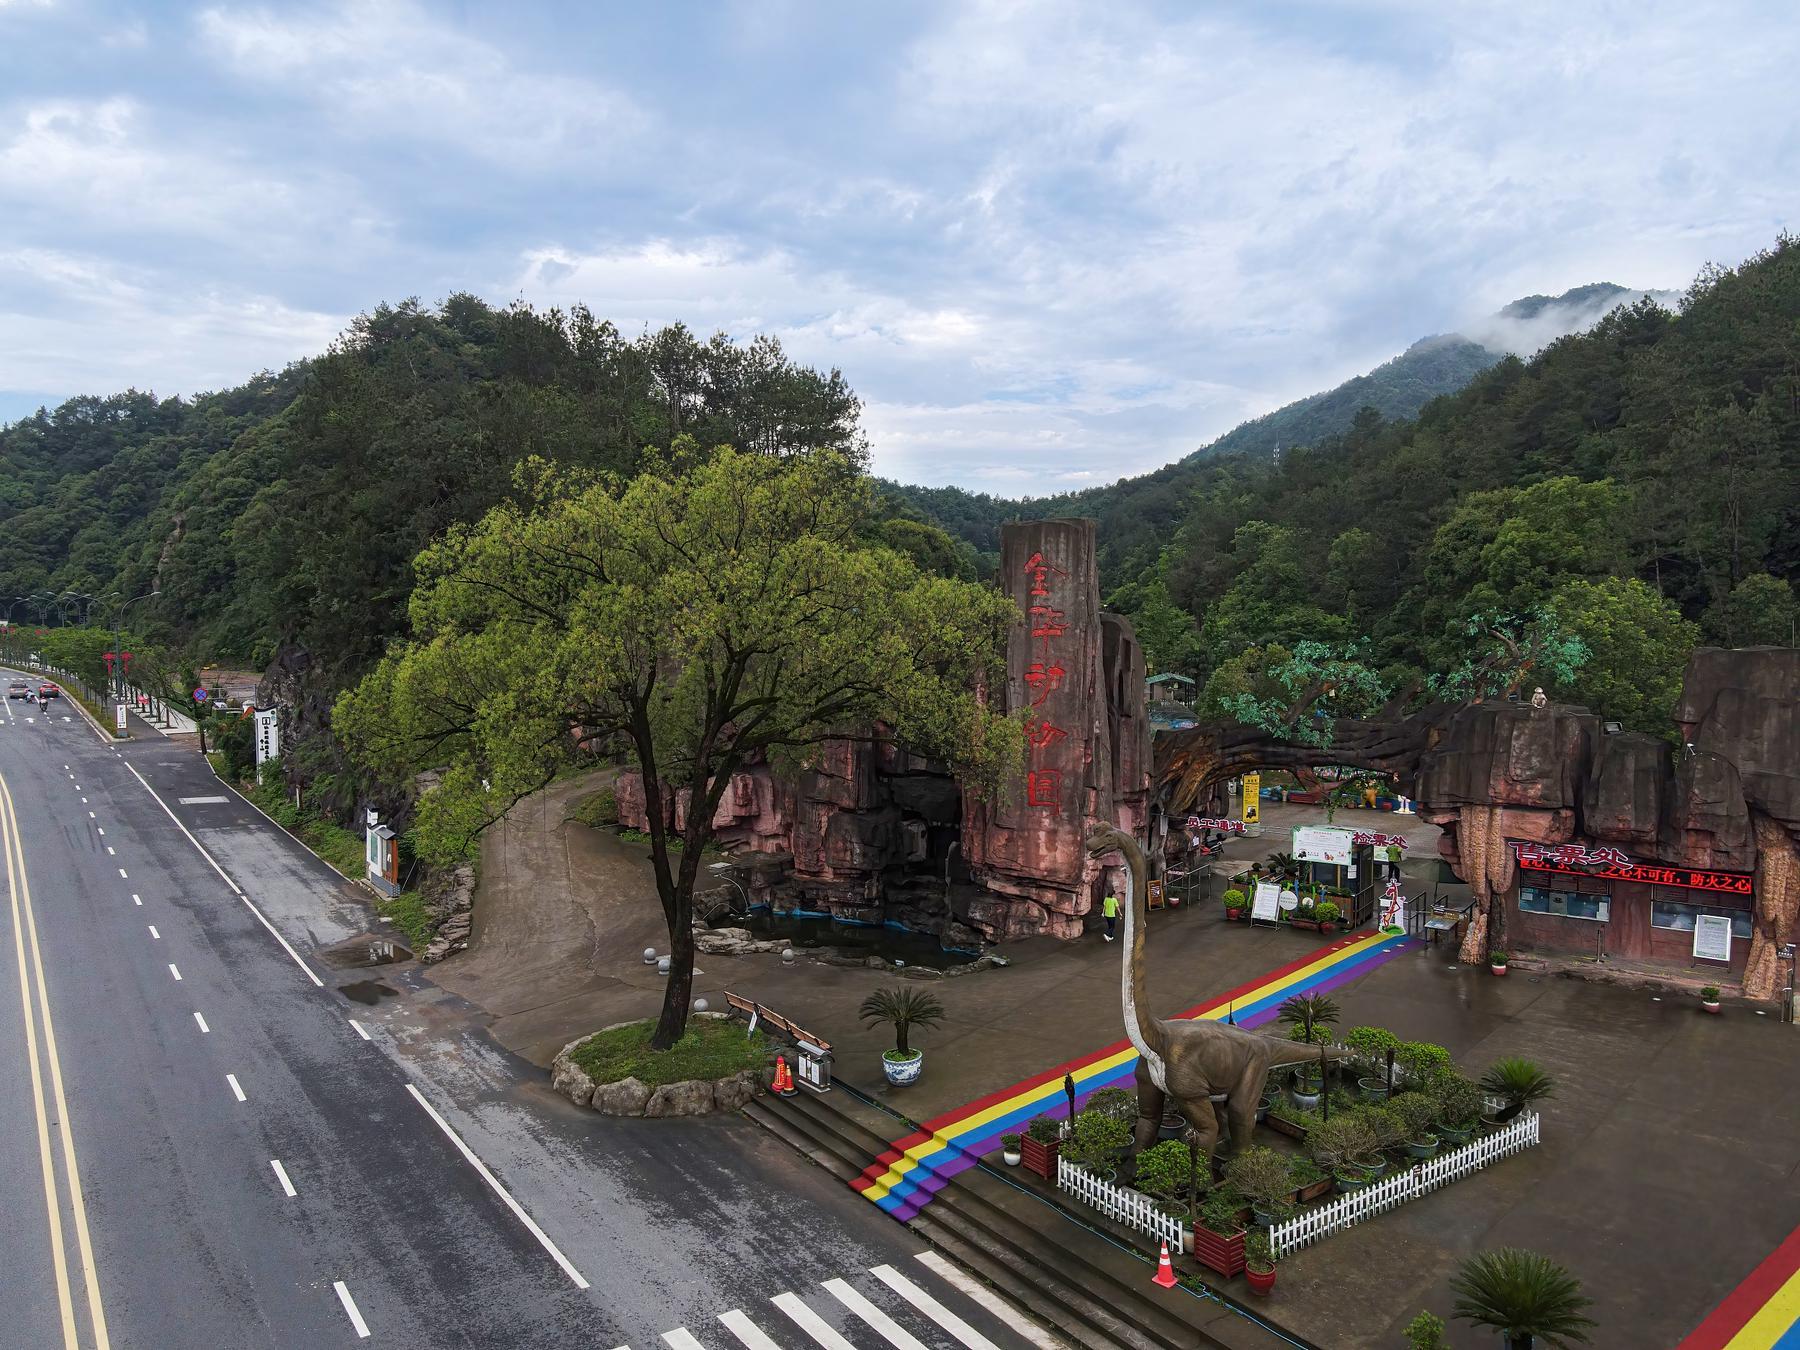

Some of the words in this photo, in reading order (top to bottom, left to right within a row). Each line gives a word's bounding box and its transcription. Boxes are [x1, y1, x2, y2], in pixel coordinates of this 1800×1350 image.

[1024, 551, 1069, 816] 金华动物园
[1186, 816, 1247, 833] 员工通道
[1352, 831, 1409, 850] 检票处
[1508, 841, 1634, 870] 售票处
